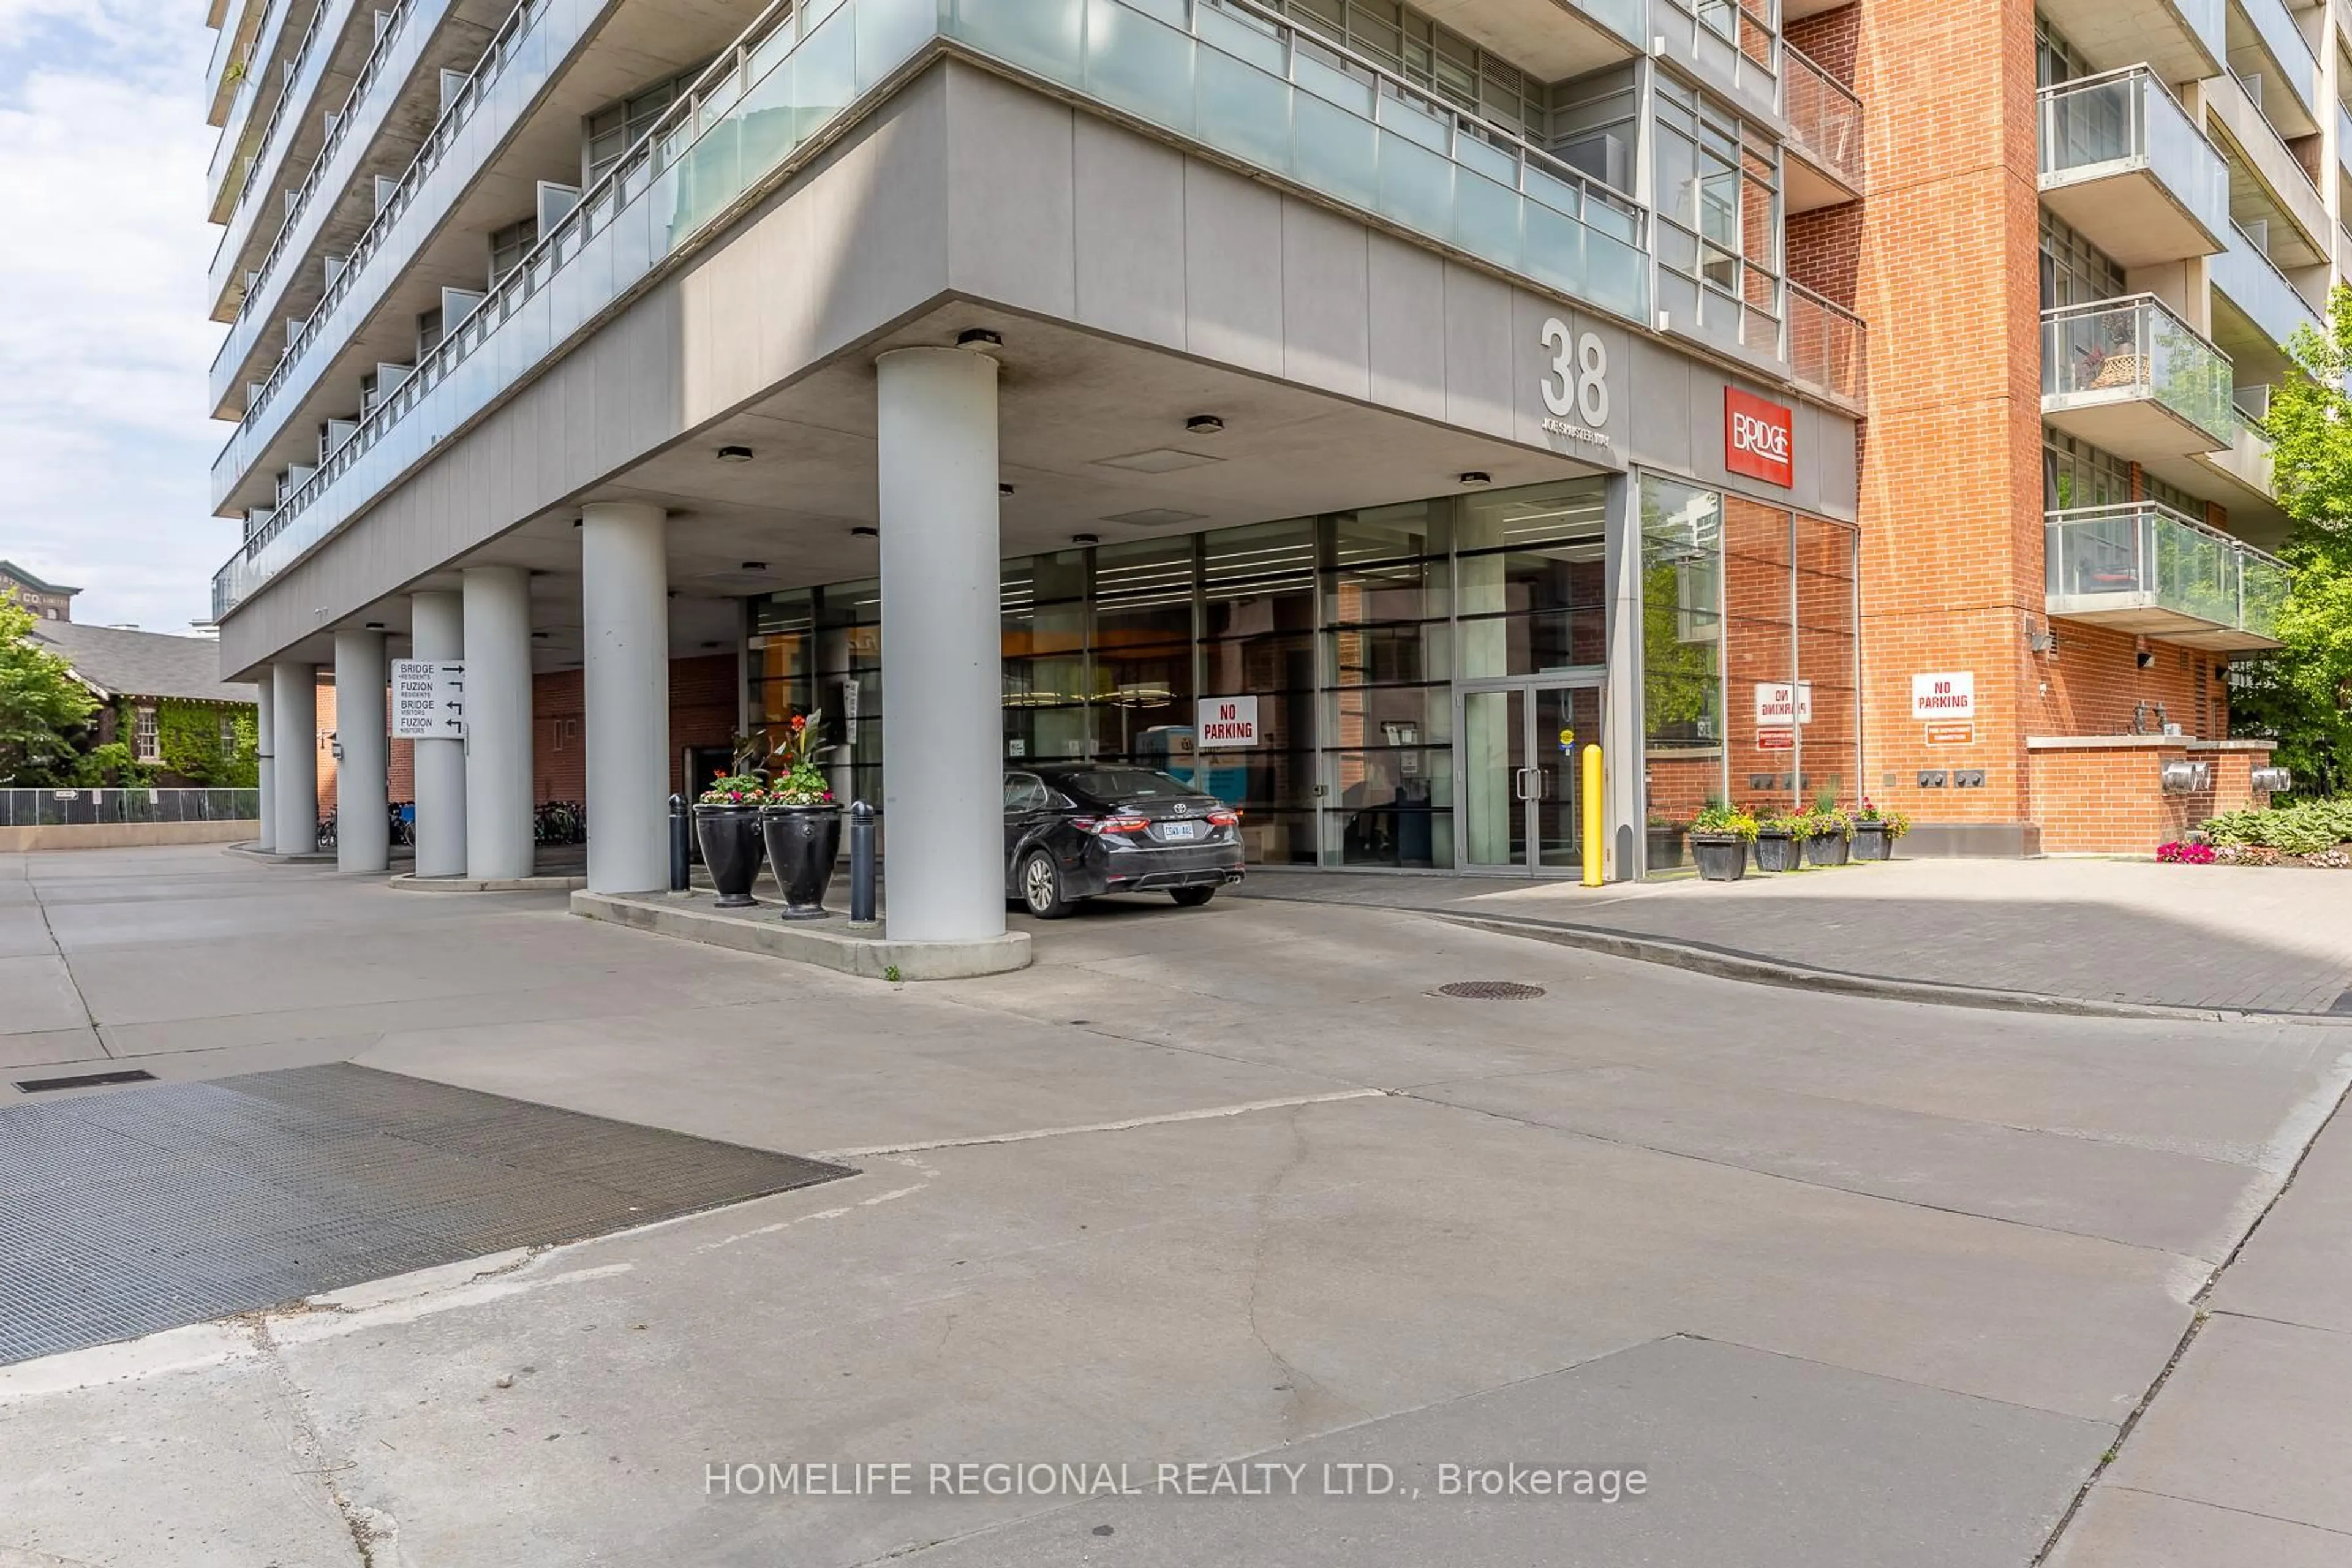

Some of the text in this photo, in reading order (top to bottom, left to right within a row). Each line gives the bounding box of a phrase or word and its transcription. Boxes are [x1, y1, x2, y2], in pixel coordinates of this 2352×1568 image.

[1540, 317, 1609, 428] 38
[1542, 418, 1559, 433] JOE
[1733, 411, 1789, 464] BRIDGE
[401, 664, 434, 673] BRIDGE
[401, 682, 433, 691] FUZION
[1935, 682, 1950, 694] NO
[1918, 695, 1968, 709] PARKING
[1220, 704, 1235, 720] NO
[401, 718, 432, 727] FUZION
[1204, 722, 1253, 739] PARKING
